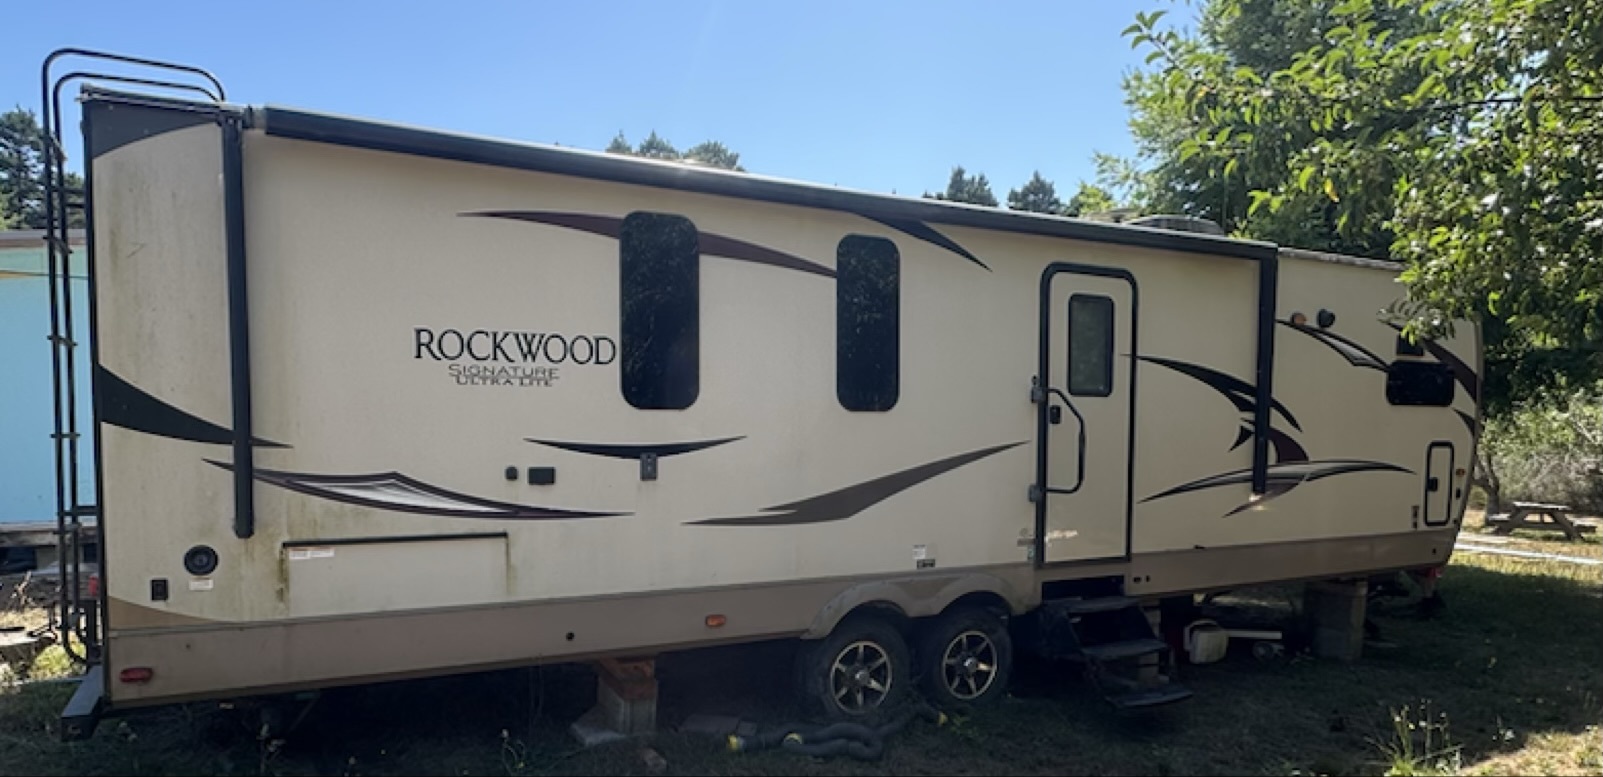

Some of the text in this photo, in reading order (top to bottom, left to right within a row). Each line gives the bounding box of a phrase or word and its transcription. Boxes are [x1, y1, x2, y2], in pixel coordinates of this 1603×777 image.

[413, 328, 617, 365] ROCKWOOD
[448, 363, 560, 380] SIGNATURE
[455, 375, 553, 388] ULTRA LITE
